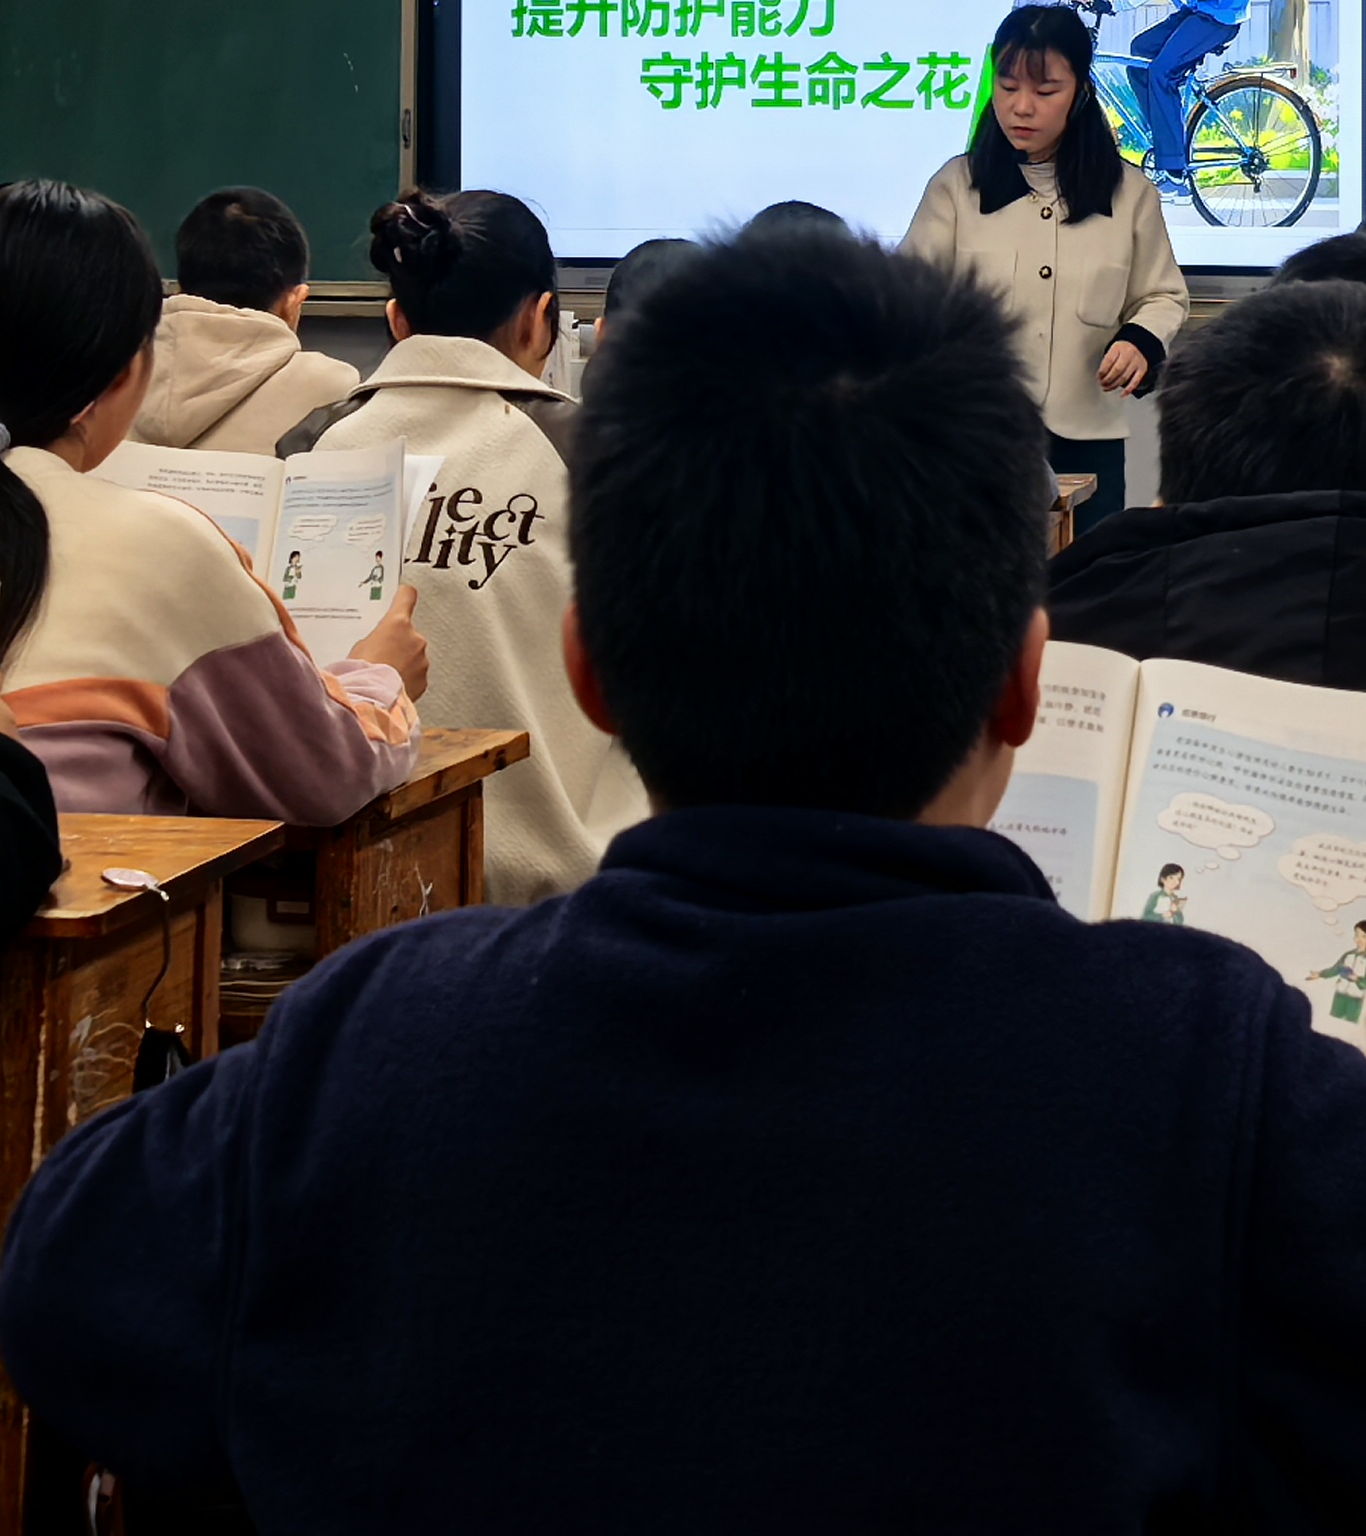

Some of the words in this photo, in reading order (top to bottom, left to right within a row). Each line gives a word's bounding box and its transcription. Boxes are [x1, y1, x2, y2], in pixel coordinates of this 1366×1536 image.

[639, 51, 972, 111] 守护生命之花
